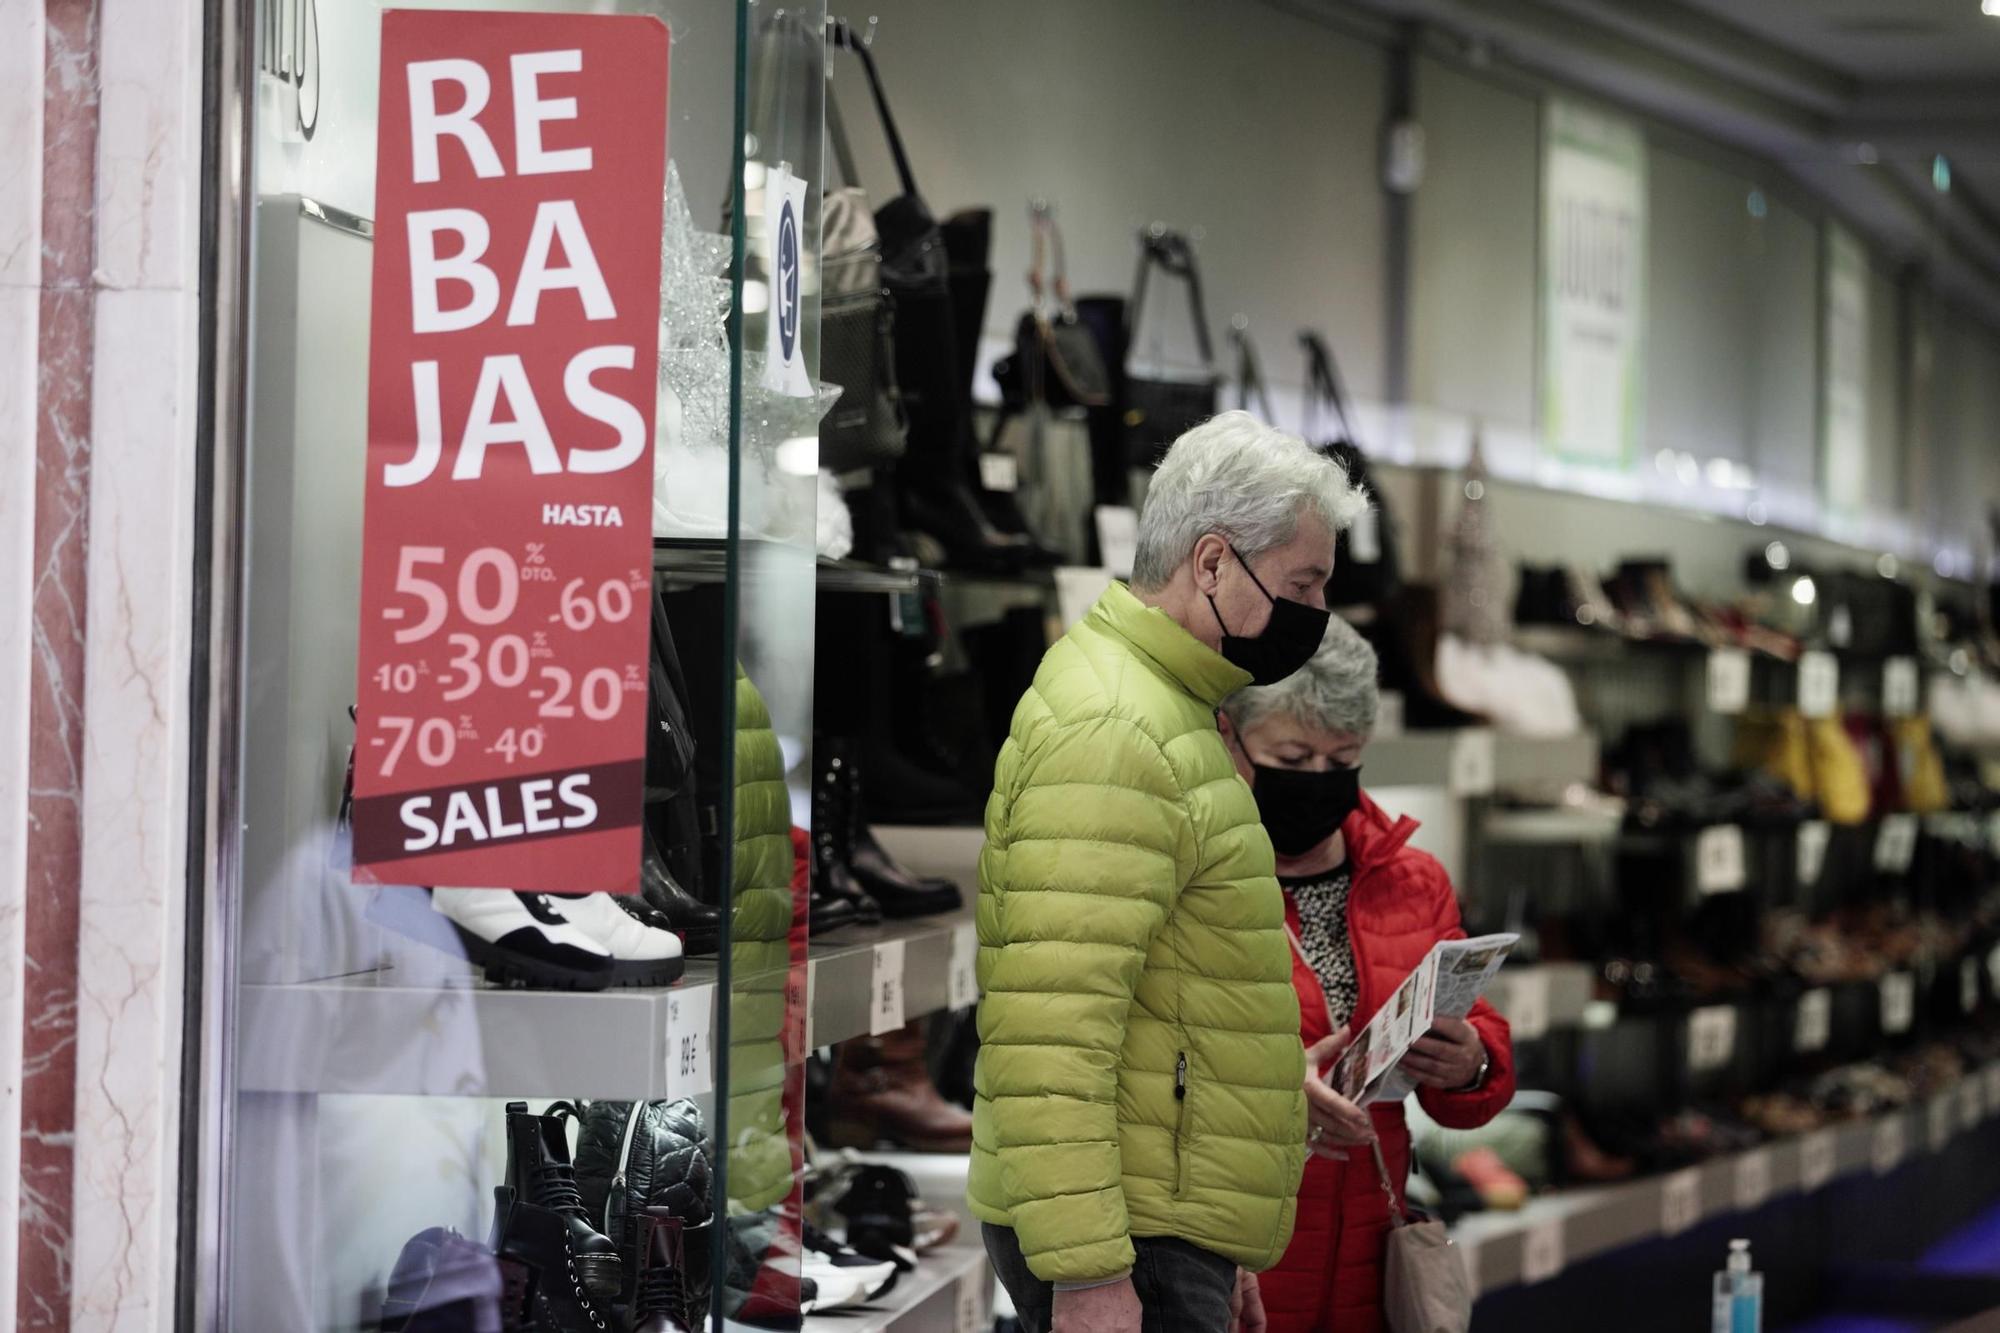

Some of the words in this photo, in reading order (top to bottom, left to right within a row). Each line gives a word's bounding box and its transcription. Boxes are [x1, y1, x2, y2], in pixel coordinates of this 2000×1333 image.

[407, 49, 592, 184] RE
[407, 200, 617, 333] BA
[384, 345, 646, 487] JAS
[542, 504, 622, 527] HASTA
[383, 546, 519, 643] -50
[525, 542, 545, 564] %
[521, 566, 556, 581] DTO.
[549, 577, 632, 631] -60
[373, 663, 417, 693] -10
[437, 633, 530, 701] -30
[529, 666, 622, 720] -20
[370, 716, 456, 777] -70
[485, 727, 543, 764] -40
[400, 774, 598, 851] SALES
